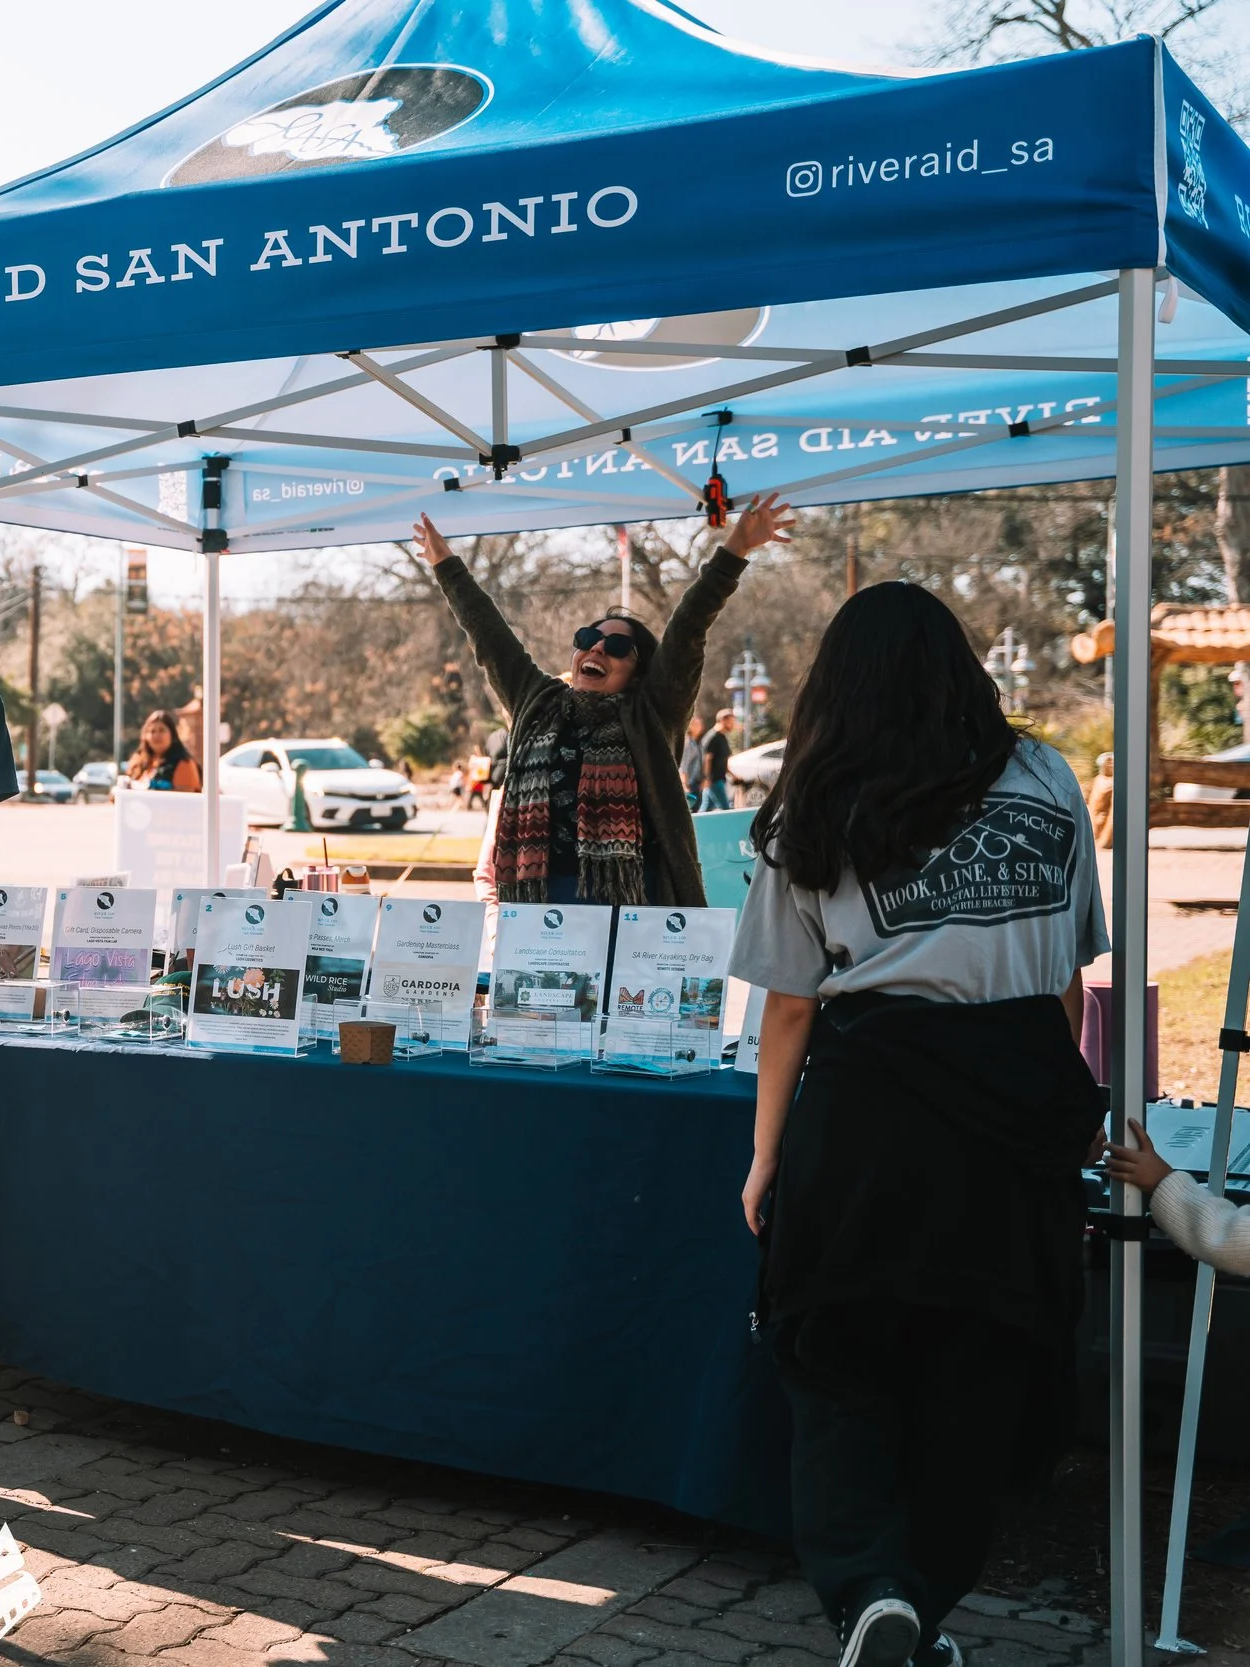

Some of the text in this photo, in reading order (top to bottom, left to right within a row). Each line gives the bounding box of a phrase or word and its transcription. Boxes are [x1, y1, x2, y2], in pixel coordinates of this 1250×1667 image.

[831, 137, 1054, 188] riveraid_sa
[76, 238, 224, 293] SAN
[250, 185, 639, 271] ANTONIO
[1003, 809, 1065, 842] TACKLE
[881, 878, 937, 912] HOOK,
[939, 863, 992, 893] LINE,
[998, 862, 1010, 881] &
[931, 886, 978, 911] COASTAL
[205, 904, 213, 912] 2
[503, 910, 517, 918] 10
[624, 913, 639, 921] 11
[90, 927, 120, 936] Disposable
[121, 927, 143, 935] Camera
[313, 934, 333, 943] Passes,
[227, 943, 242, 951] Lush
[255, 945, 276, 953] Basket
[396, 940, 460, 950] Gardening Masterclass
[514, 947, 587, 957] Landscape Consultation
[631, 951, 641, 959] SA
[642, 952, 658, 960] River
[688, 953, 700, 963] Dry
[701, 954, 714, 963] Bag
[305, 974, 348, 986] WILD RICE
[401, 979, 461, 991] GARDOPIA
[212, 977, 281, 1001] LUSH
[327, 984, 347, 993] Studio
[617, 1004, 643, 1012] REMOTE
